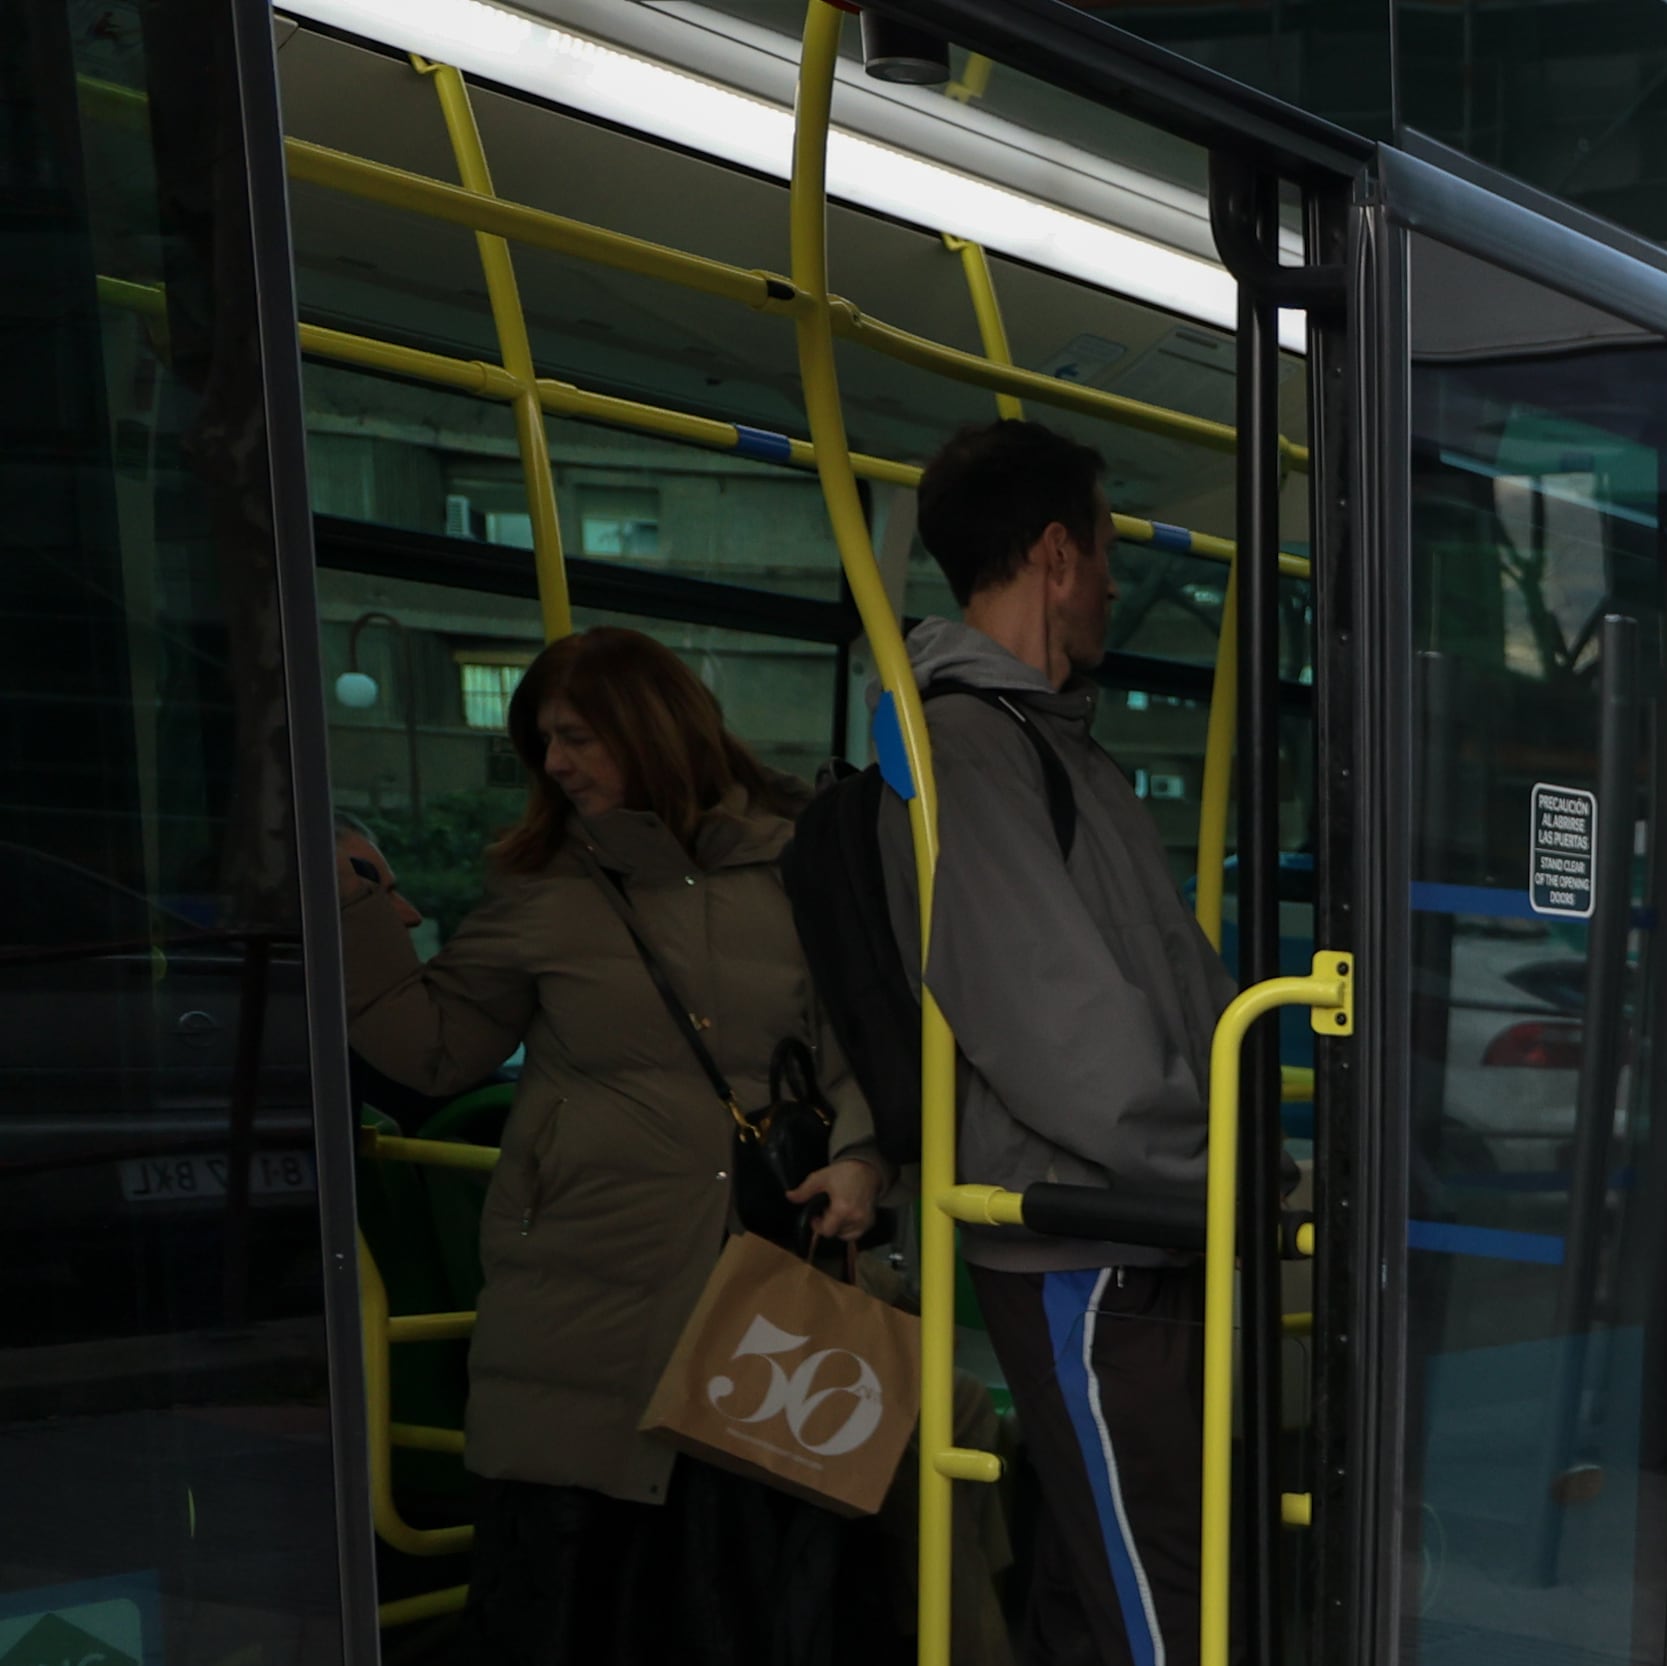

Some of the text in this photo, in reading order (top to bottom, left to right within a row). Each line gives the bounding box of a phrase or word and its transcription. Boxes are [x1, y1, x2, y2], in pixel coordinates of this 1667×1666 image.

[1538, 794, 1590, 816] PRECAUCIÓN
[1553, 815, 1585, 833] ABRIRSE
[1538, 830, 1589, 851] LAS PUERTAS
[1540, 856, 1585, 874] STAND CLEAR
[1559, 876, 1590, 891] OPENING
[706, 1313, 884, 1457] 50
